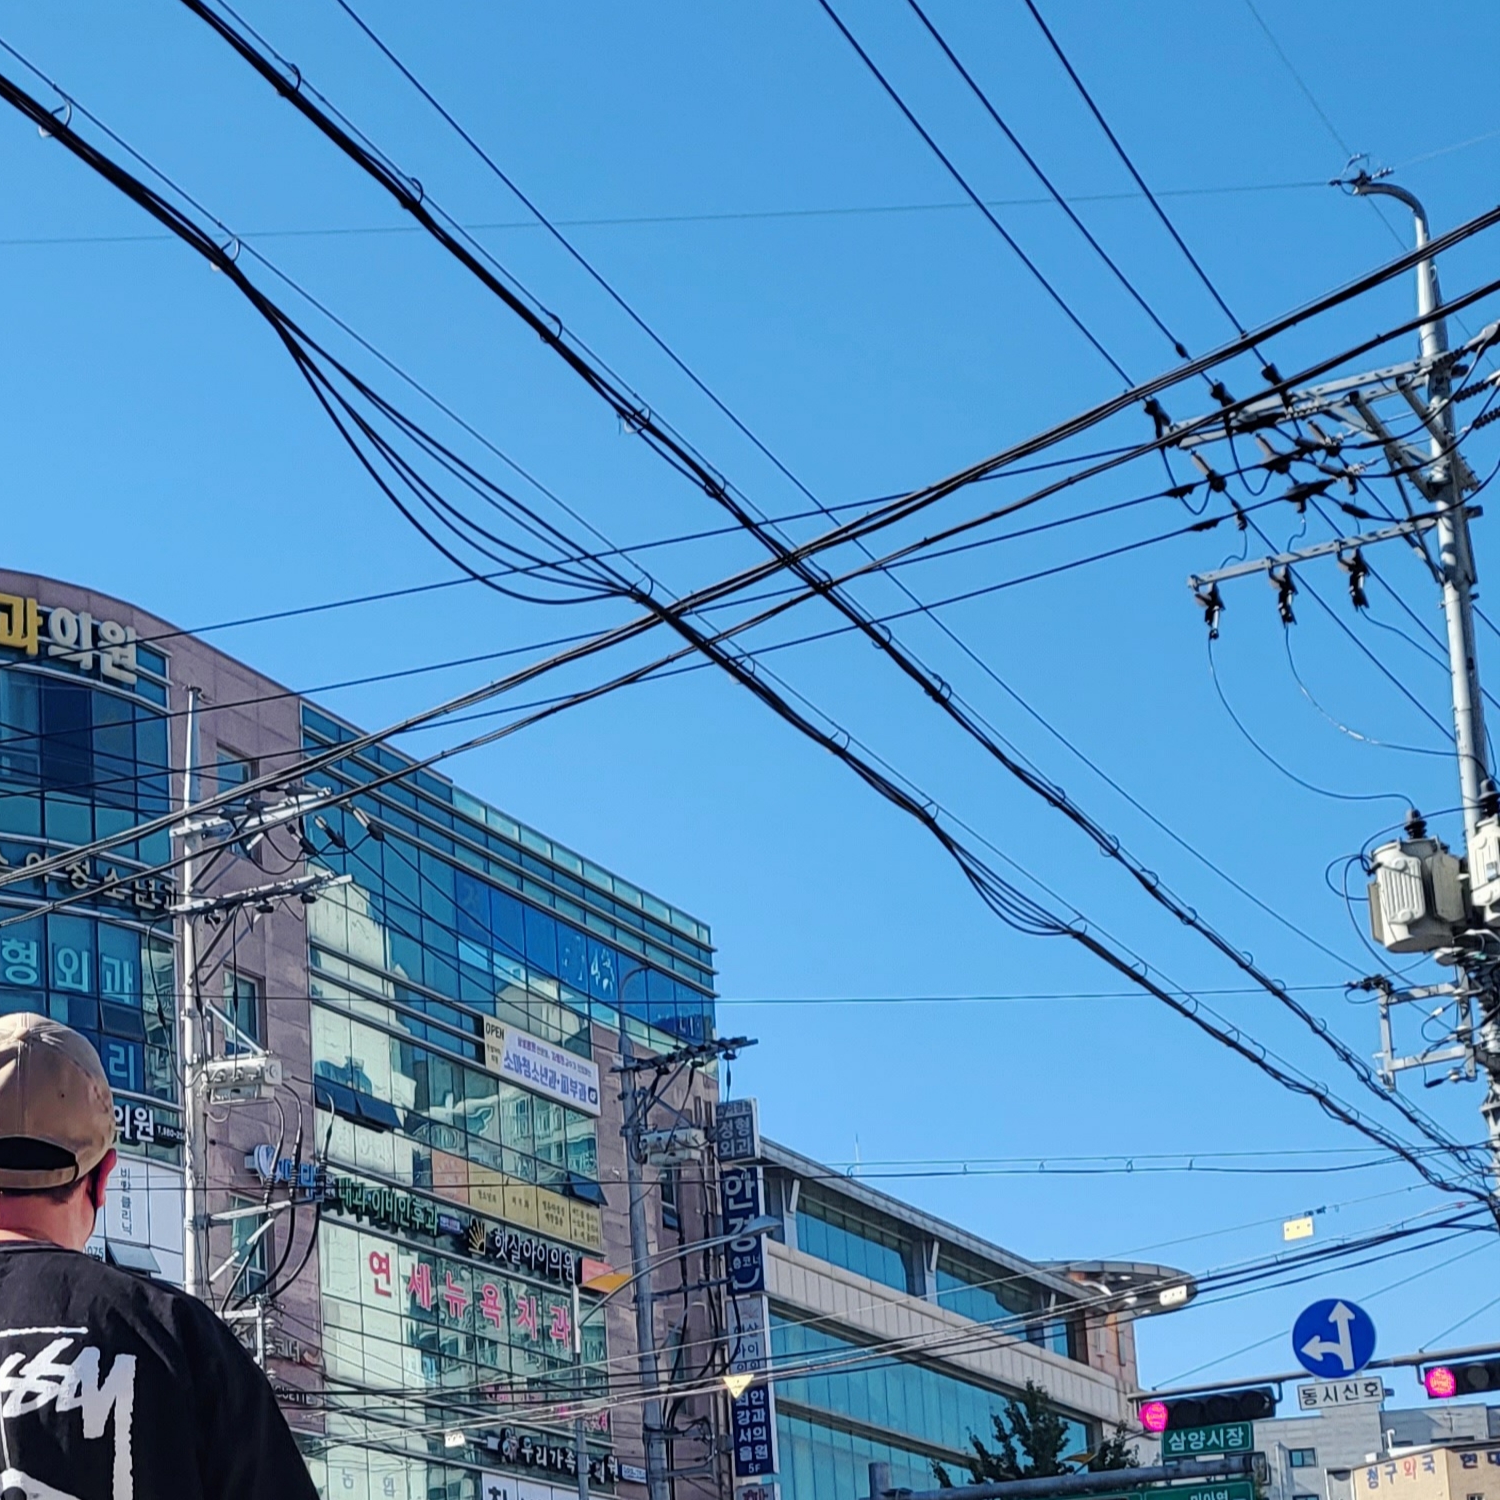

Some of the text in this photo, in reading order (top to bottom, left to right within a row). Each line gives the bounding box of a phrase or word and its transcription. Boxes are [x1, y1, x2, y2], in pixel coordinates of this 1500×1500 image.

[485, 1022, 504, 1041] OPEN
[494, 1228, 575, 1281] 햇살아이의원
[368, 1250, 571, 1348] 연세뉴욕치과
[1301, 1381, 1381, 1406] 동시신호
[1168, 1425, 1245, 1452] 삼양시장
[748, 1461, 762, 1474] 5F
